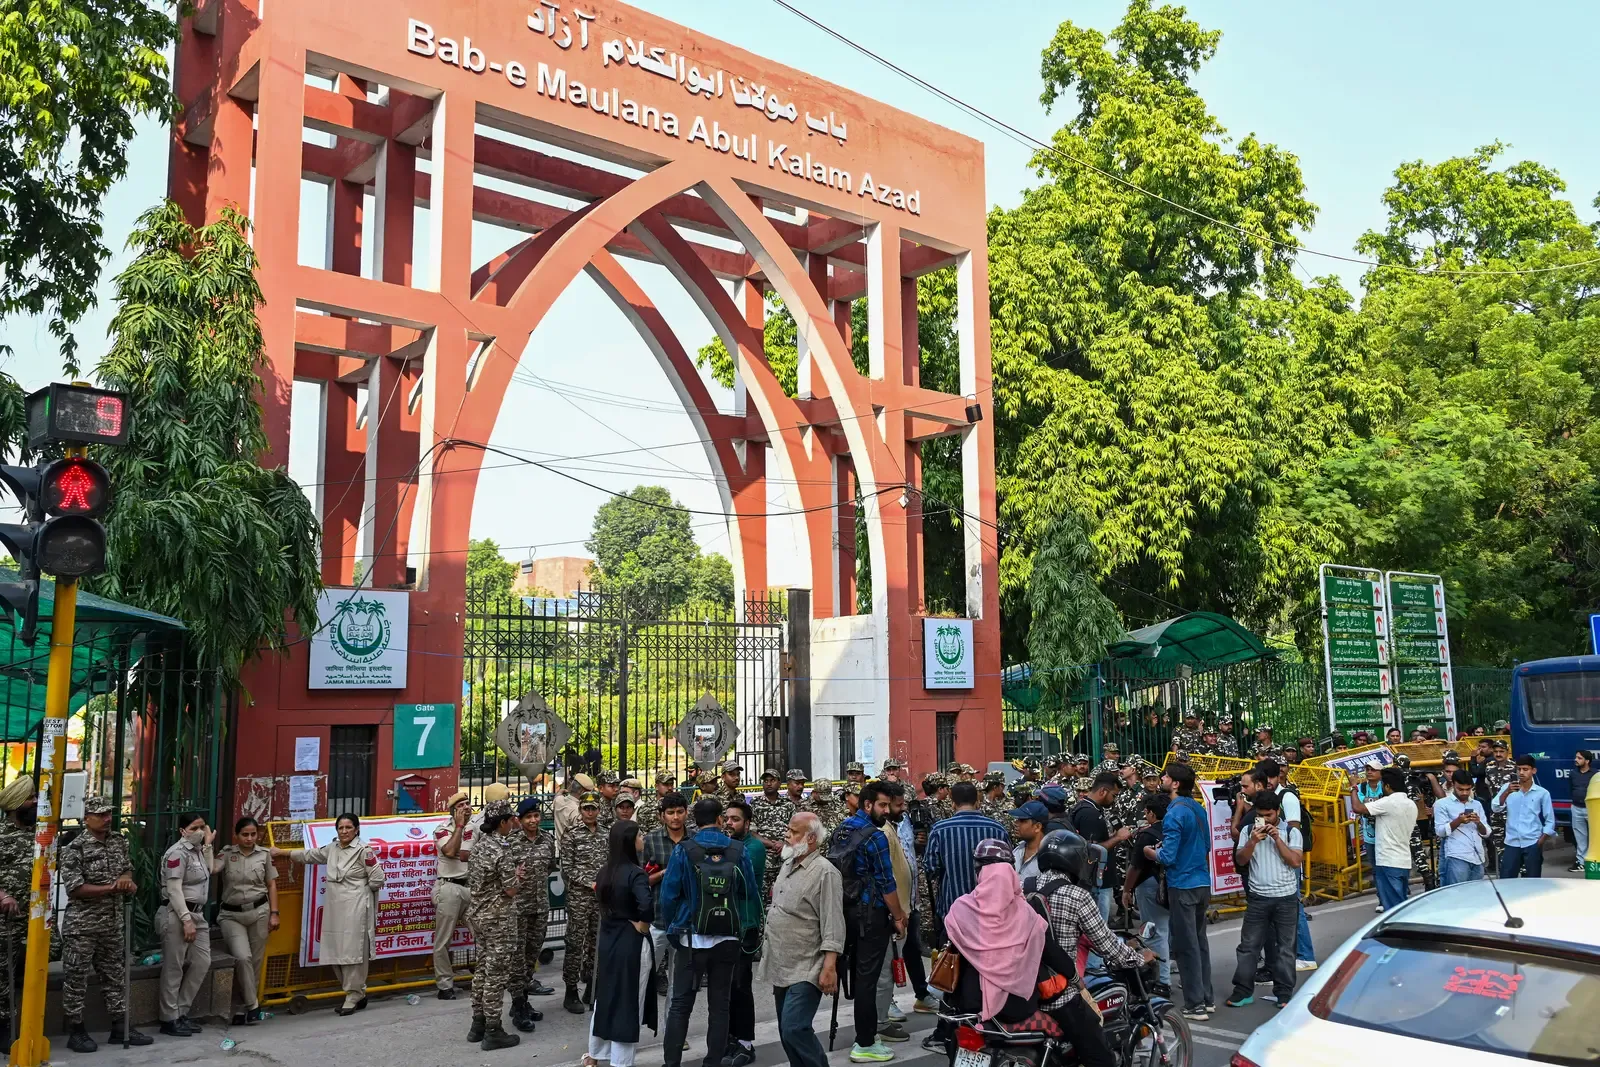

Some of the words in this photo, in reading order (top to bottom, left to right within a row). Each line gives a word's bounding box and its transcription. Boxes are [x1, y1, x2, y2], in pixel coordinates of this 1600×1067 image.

[407, 17, 527, 88] Bab-e
[537, 61, 680, 139] Maulana
[687, 115, 757, 162] Abul
[768, 139, 852, 194] Kalam
[857, 172, 921, 216] Azad
[97, 396, 123, 437] 9
[415, 703, 435, 711] Gate
[413, 716, 436, 756] 7
[708, 876, 726, 885] TVU
[380, 902, 401, 910] BNSS
